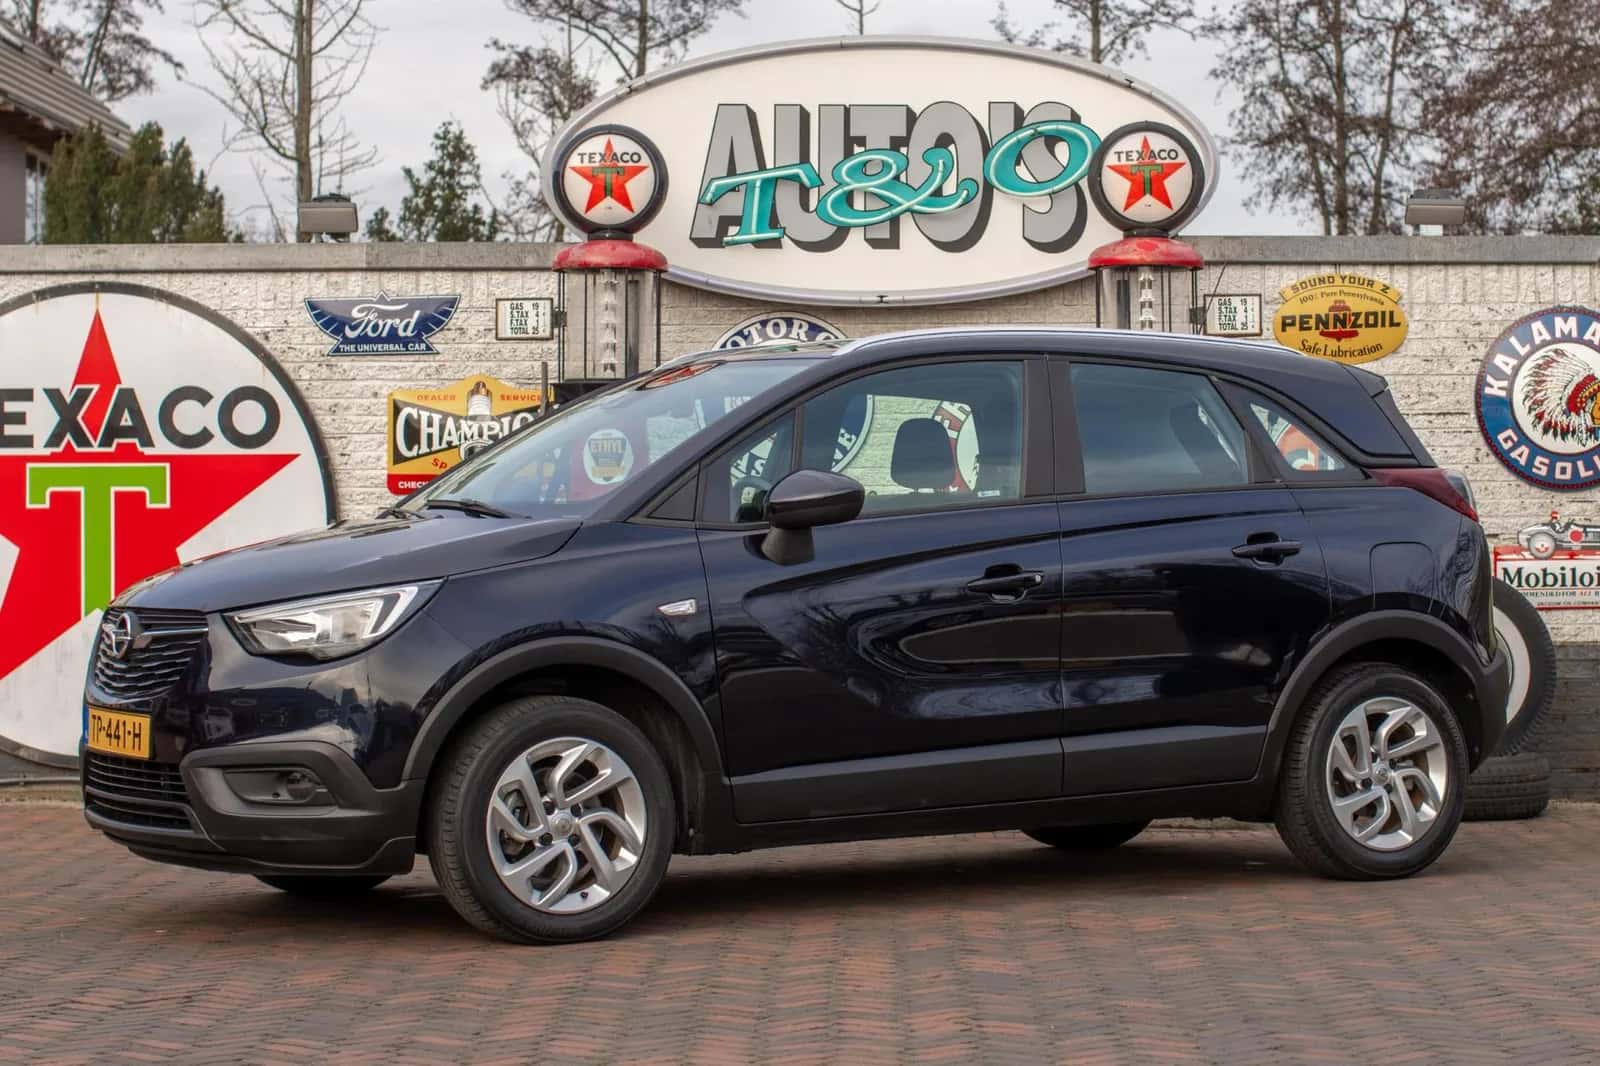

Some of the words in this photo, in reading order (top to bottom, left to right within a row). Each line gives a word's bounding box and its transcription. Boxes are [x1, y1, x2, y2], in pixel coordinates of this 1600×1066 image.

[577, 151, 642, 163] TEXACO
[1114, 149, 1179, 162] TEXACO
[689, 101, 1089, 252] AUTO'S
[1290, 275, 1335, 294] SOUND
[1340, 275, 1375, 288] YOUR
[510, 302, 524, 311] GAS
[1217, 297, 1232, 306] GAS
[344, 303, 422, 338] Ford
[1281, 310, 1402, 333] PENNZOIL
[510, 326, 530, 335] TOTAL
[339, 344, 355, 352] THE
[357, 343, 405, 352] UNIVERSAL
[407, 343, 426, 351] CAR
[1300, 338, 1322, 354] Safe
[1323, 342, 1383, 358] Lubrication
[395, 406, 542, 457] CHAMPI
[91, 714, 142, 752] TP-441-H
